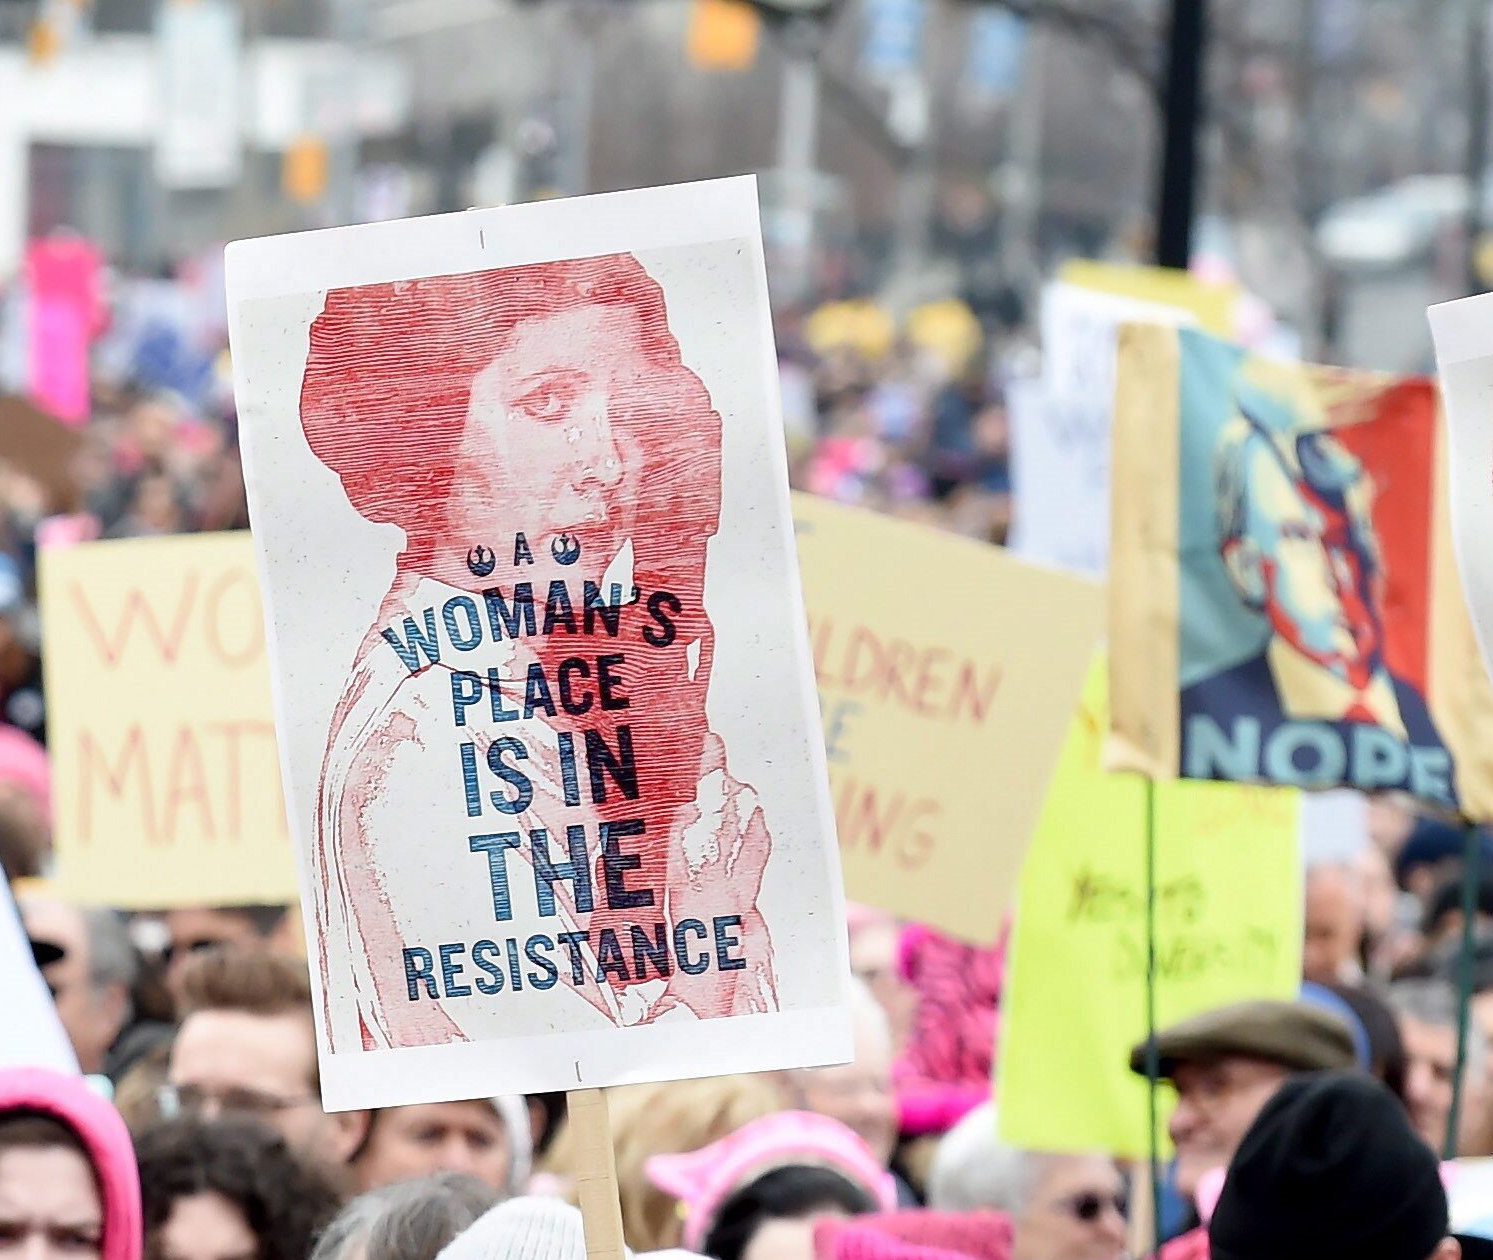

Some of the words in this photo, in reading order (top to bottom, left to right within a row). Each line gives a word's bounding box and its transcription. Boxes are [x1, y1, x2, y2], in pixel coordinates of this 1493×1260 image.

[513, 531, 535, 566] A
[380, 579, 683, 677] WOMAN'S
[450, 653, 631, 727] PLACE
[460, 737, 534, 818] IS
[557, 724, 641, 807] IN
[1185, 713, 1457, 803] NOPE
[468, 818, 655, 922] THE
[402, 914, 747, 1001] RESISTANCE
